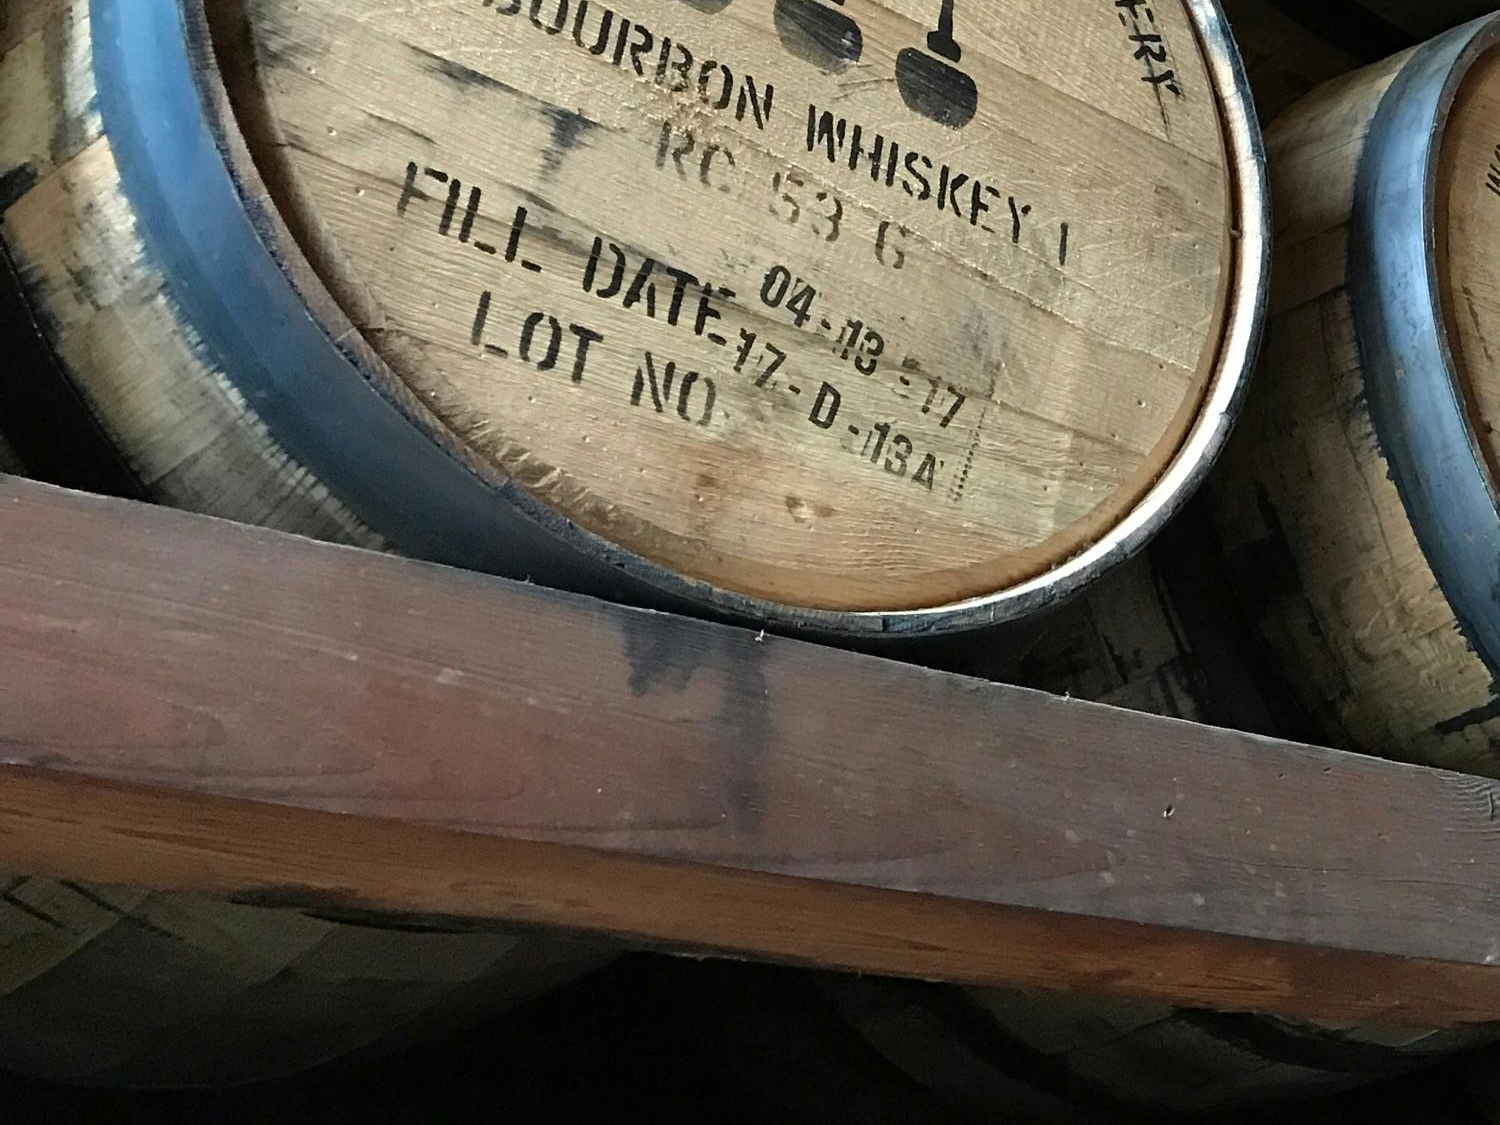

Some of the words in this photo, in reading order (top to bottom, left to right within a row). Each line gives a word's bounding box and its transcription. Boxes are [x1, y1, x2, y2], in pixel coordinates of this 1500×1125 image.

[397, 160, 543, 273] FILL
[767, 171, 844, 243] 53
[806, 103, 1032, 244] WHISKEY
[470, 290, 604, 384] LOT
